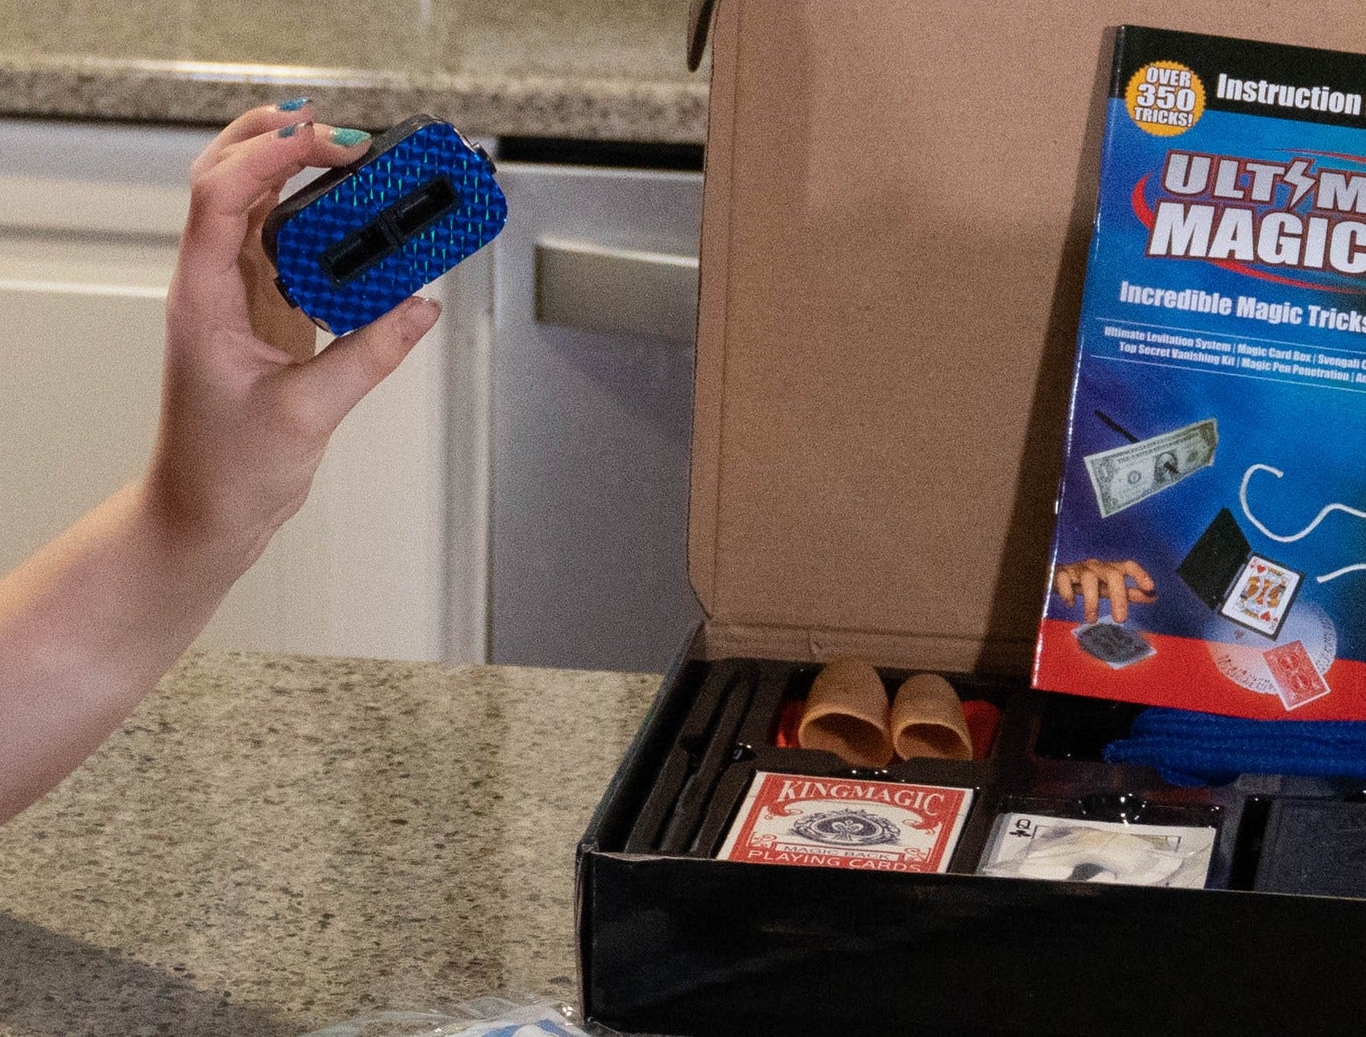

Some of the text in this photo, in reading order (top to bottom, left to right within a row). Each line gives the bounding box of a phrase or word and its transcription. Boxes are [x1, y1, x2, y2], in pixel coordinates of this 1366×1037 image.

[1146, 66, 1191, 88] OVER
[1217, 73, 1361, 114] Instruction
[1136, 83, 1196, 112] 350
[1134, 107, 1193, 127] TRICKS!
[1120, 280, 1233, 316] Incredible
[1237, 296, 1303, 325] Magic
[1104, 325, 1145, 342] Ultimate
[1146, 331, 1194, 349] Levitation
[1195, 337, 1231, 354] System
[1237, 343, 1268, 357] Magic
[1268, 347, 1292, 360] Card
[1293, 350, 1312, 363] Box
[1318, 354, 1360, 372] Svengali
[1119, 340, 1137, 354] Top
[1138, 343, 1172, 359] Secret
[1171, 348, 1221, 366] Vanishing
[1221, 354, 1236, 367] Kit
[1241, 357, 1272, 372] Magic
[1272, 362, 1292, 374] Pen
[1292, 364, 1350, 382] Penetration
[778, 780, 945, 817] KINGMAGIC
[747, 849, 923, 872] PLAYING CARDS
[783, 845, 839, 858] MAGIC
